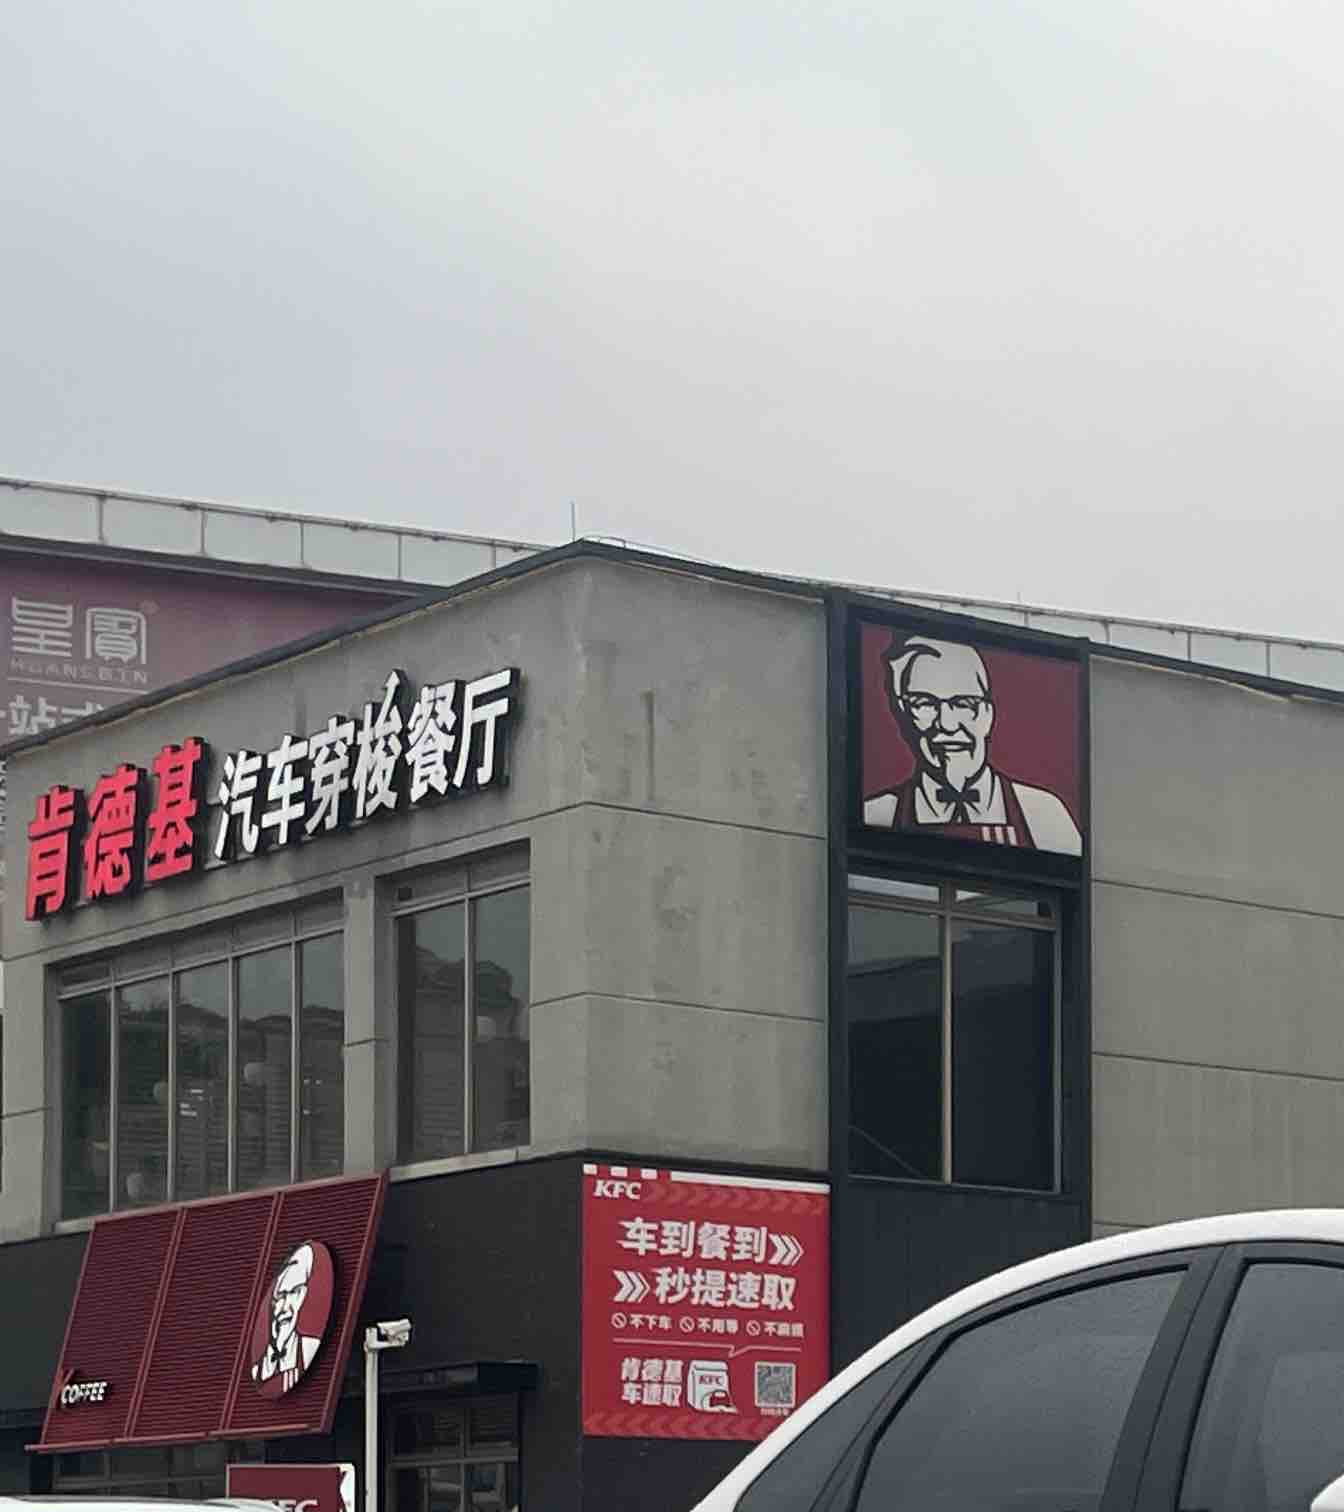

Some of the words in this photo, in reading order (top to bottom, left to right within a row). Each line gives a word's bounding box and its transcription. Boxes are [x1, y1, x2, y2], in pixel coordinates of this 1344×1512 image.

[26, 737, 204, 921] 肯德基
[214, 668, 514, 860] 汽车穿梭餐厅
[594, 1180, 641, 1200] KFC
[617, 1217, 768, 1264] 车到餐到
[653, 1266, 797, 1311] 秒提速取
[61, 1381, 108, 1404] COFFEE
